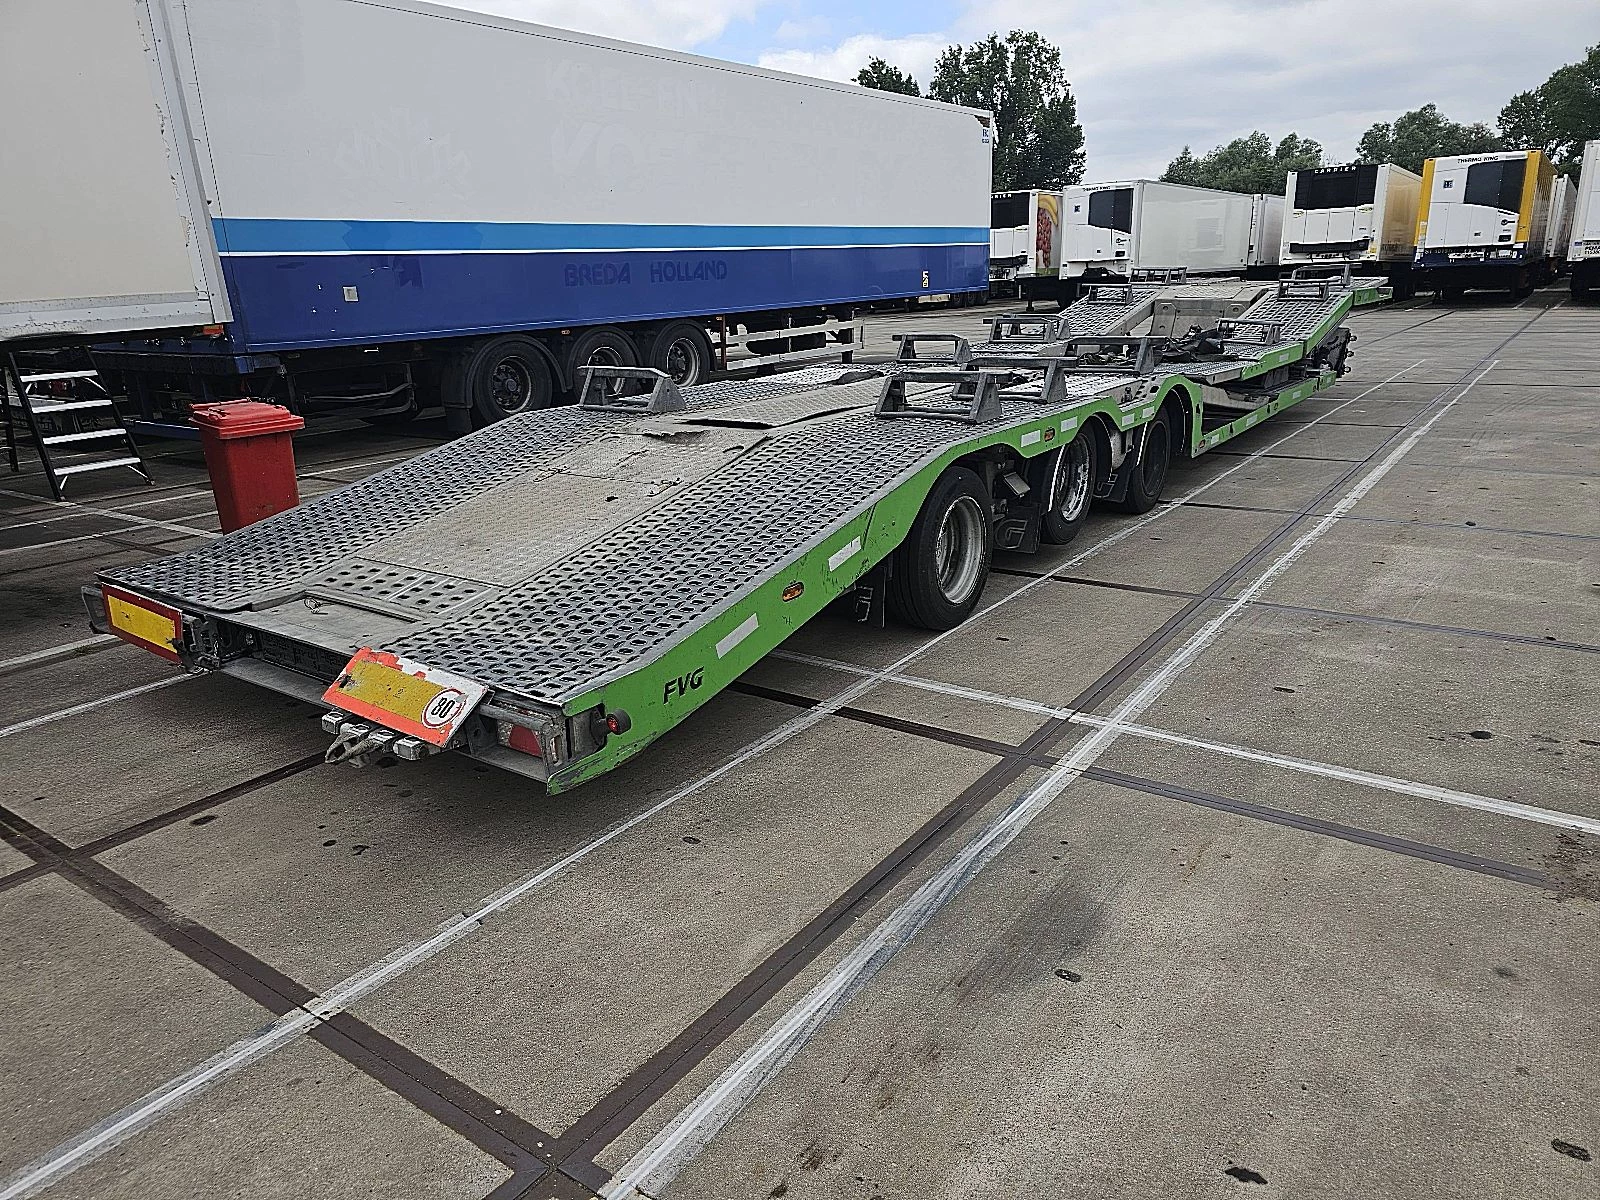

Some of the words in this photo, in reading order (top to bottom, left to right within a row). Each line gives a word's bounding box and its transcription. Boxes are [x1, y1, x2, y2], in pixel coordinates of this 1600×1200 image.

[1314, 166, 1357, 174] CARRIER
[564, 262, 632, 287] BREDA
[650, 260, 729, 284] HOLLAND
[663, 665, 705, 706] FVG
[430, 697, 456, 719] 80
